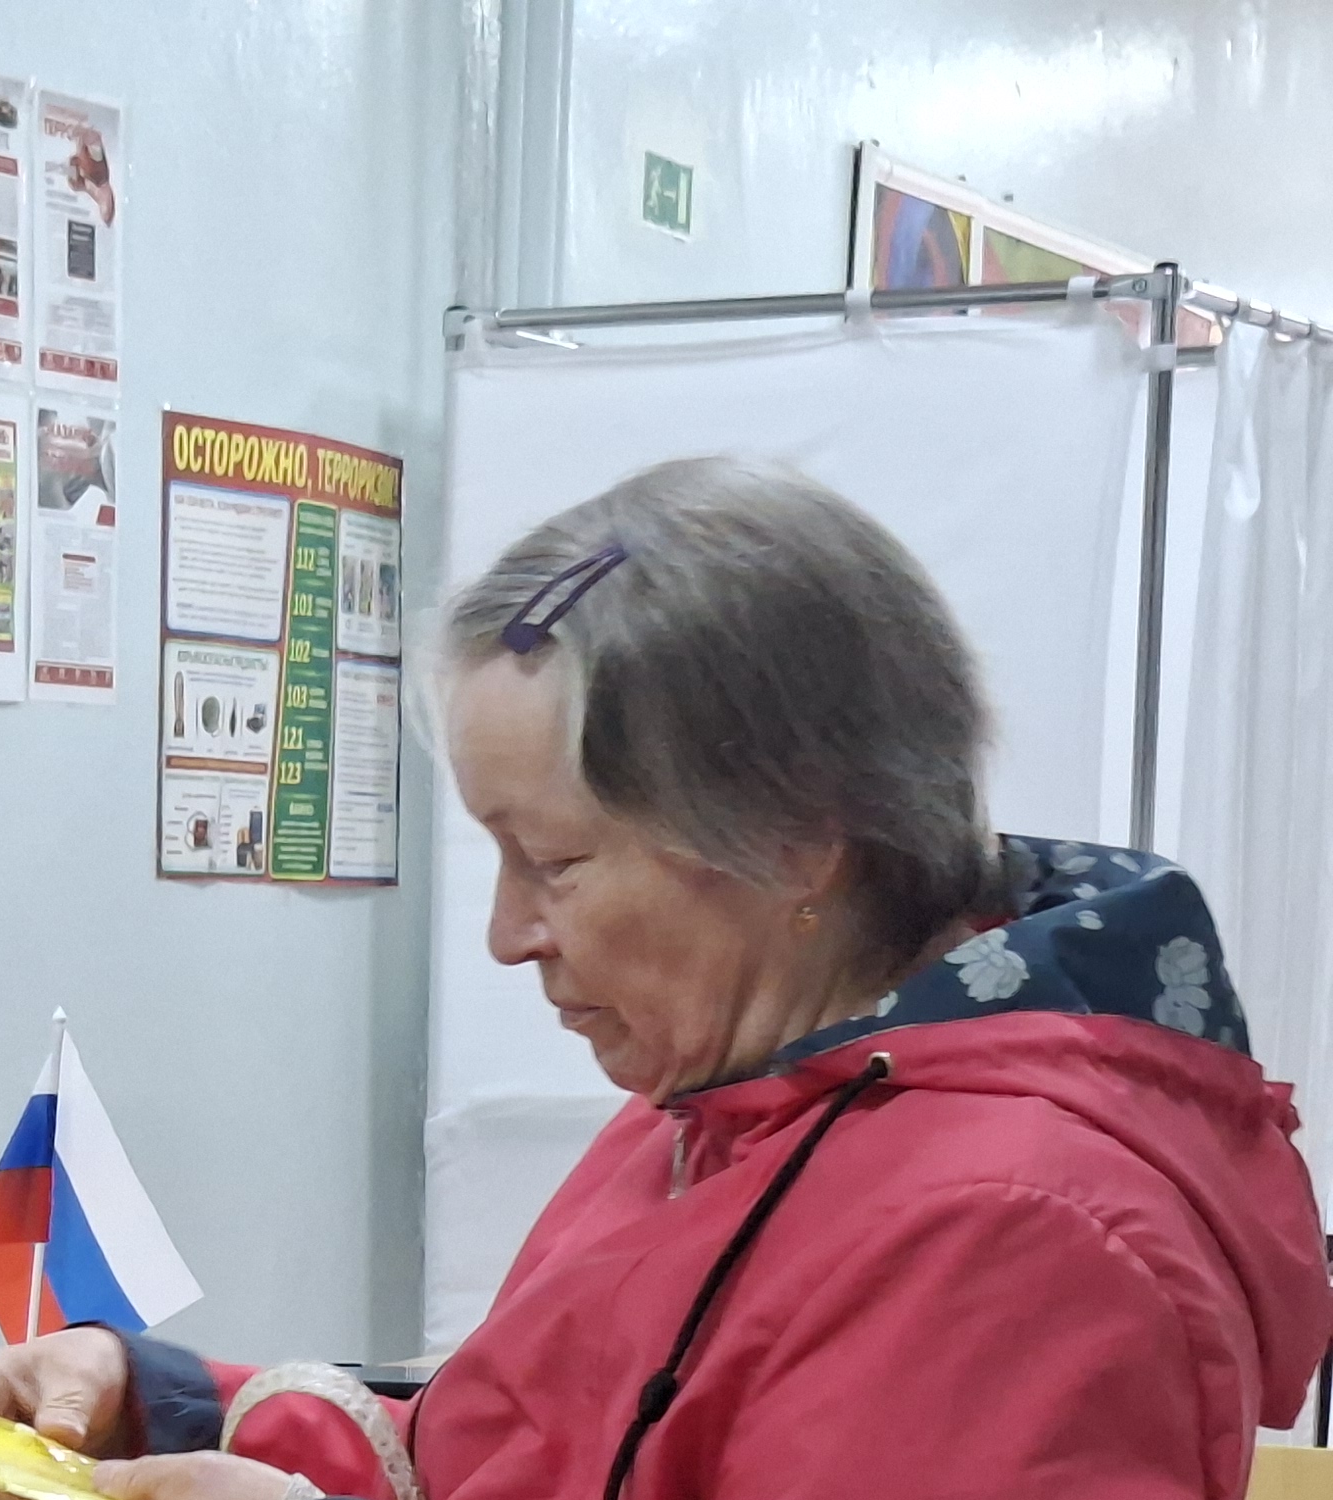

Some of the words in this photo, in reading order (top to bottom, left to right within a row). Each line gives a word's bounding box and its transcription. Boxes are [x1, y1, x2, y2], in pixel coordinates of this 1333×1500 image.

[173, 425, 313, 497] ОСТОРОЖНО,
[293, 593, 314, 616] 101
[289, 638, 311, 662] 102
[286, 684, 308, 708] 103
[283, 726, 304, 750] 121
[280, 761, 302, 784] 123
